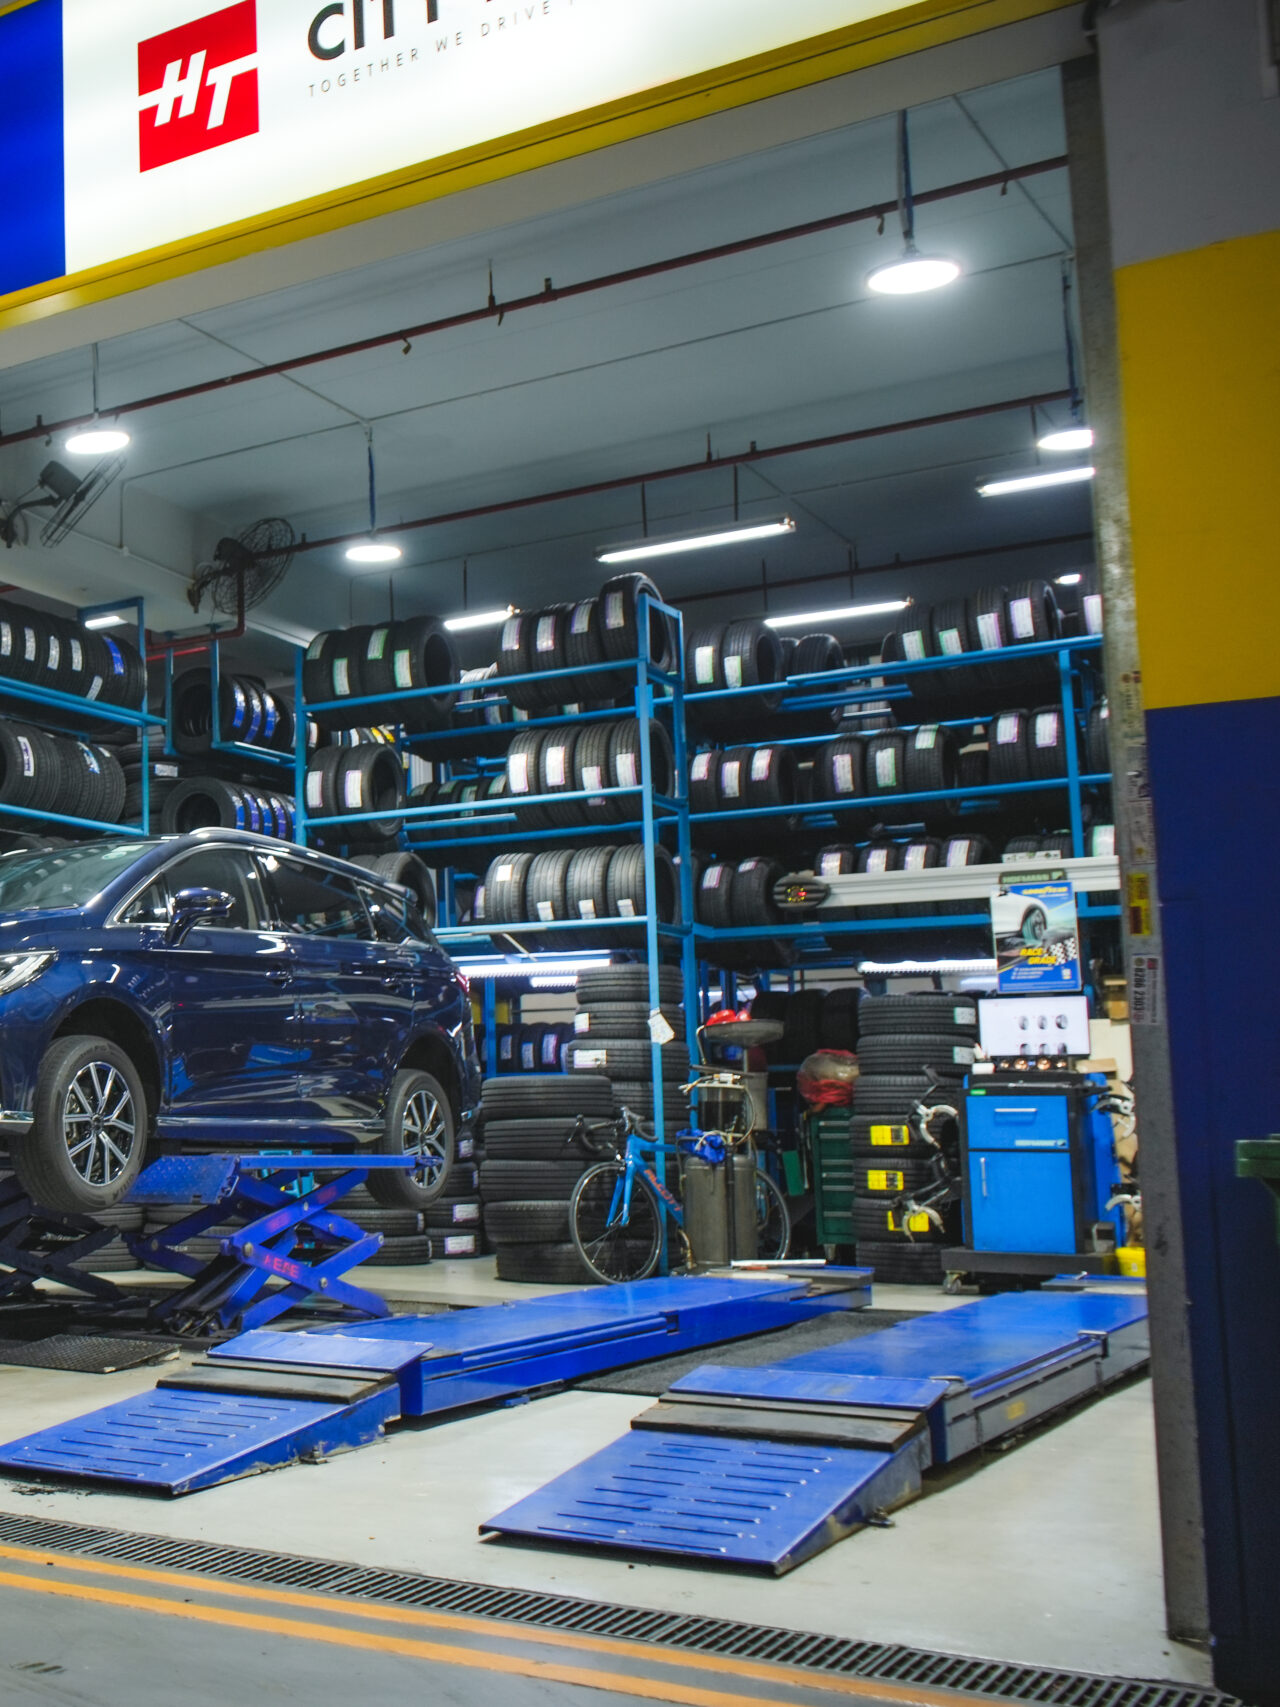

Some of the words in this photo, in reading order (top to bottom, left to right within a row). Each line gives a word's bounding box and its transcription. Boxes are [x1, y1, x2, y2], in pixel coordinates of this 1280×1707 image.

[308, 0, 438, 60] CIT
[308, 48, 419, 97] TOGETHER
[435, 32, 463, 52] WE
[481, 0, 551, 37] DRIVE
